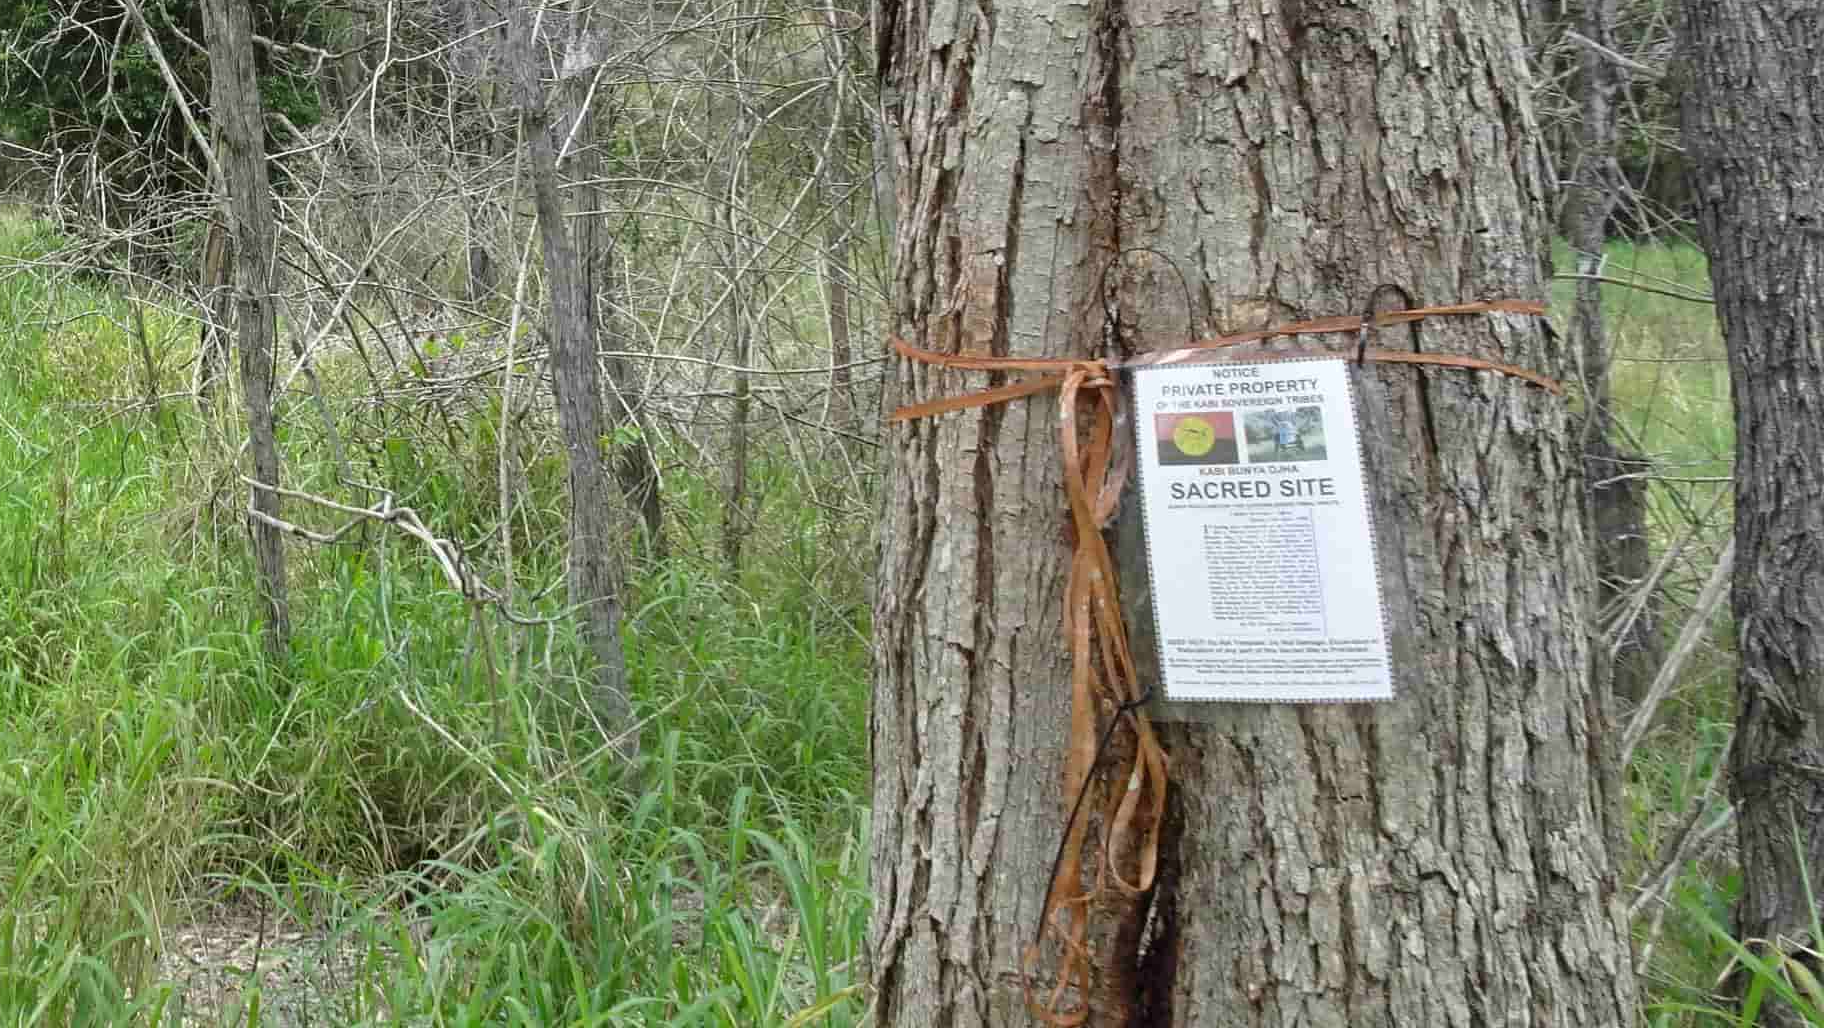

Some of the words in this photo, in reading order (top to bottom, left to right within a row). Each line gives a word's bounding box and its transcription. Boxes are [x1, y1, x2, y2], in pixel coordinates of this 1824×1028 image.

[1212, 367, 1259, 379] NOTICE
[1162, 383, 1224, 397] PRIVATE
[1229, 379, 1318, 394] PROPERTY
[1221, 397, 1283, 407] SOVEREIGN
[1286, 394, 1324, 404] TRIBES
[1170, 480, 1272, 500] SACRED
[1279, 477, 1336, 497] SITE
